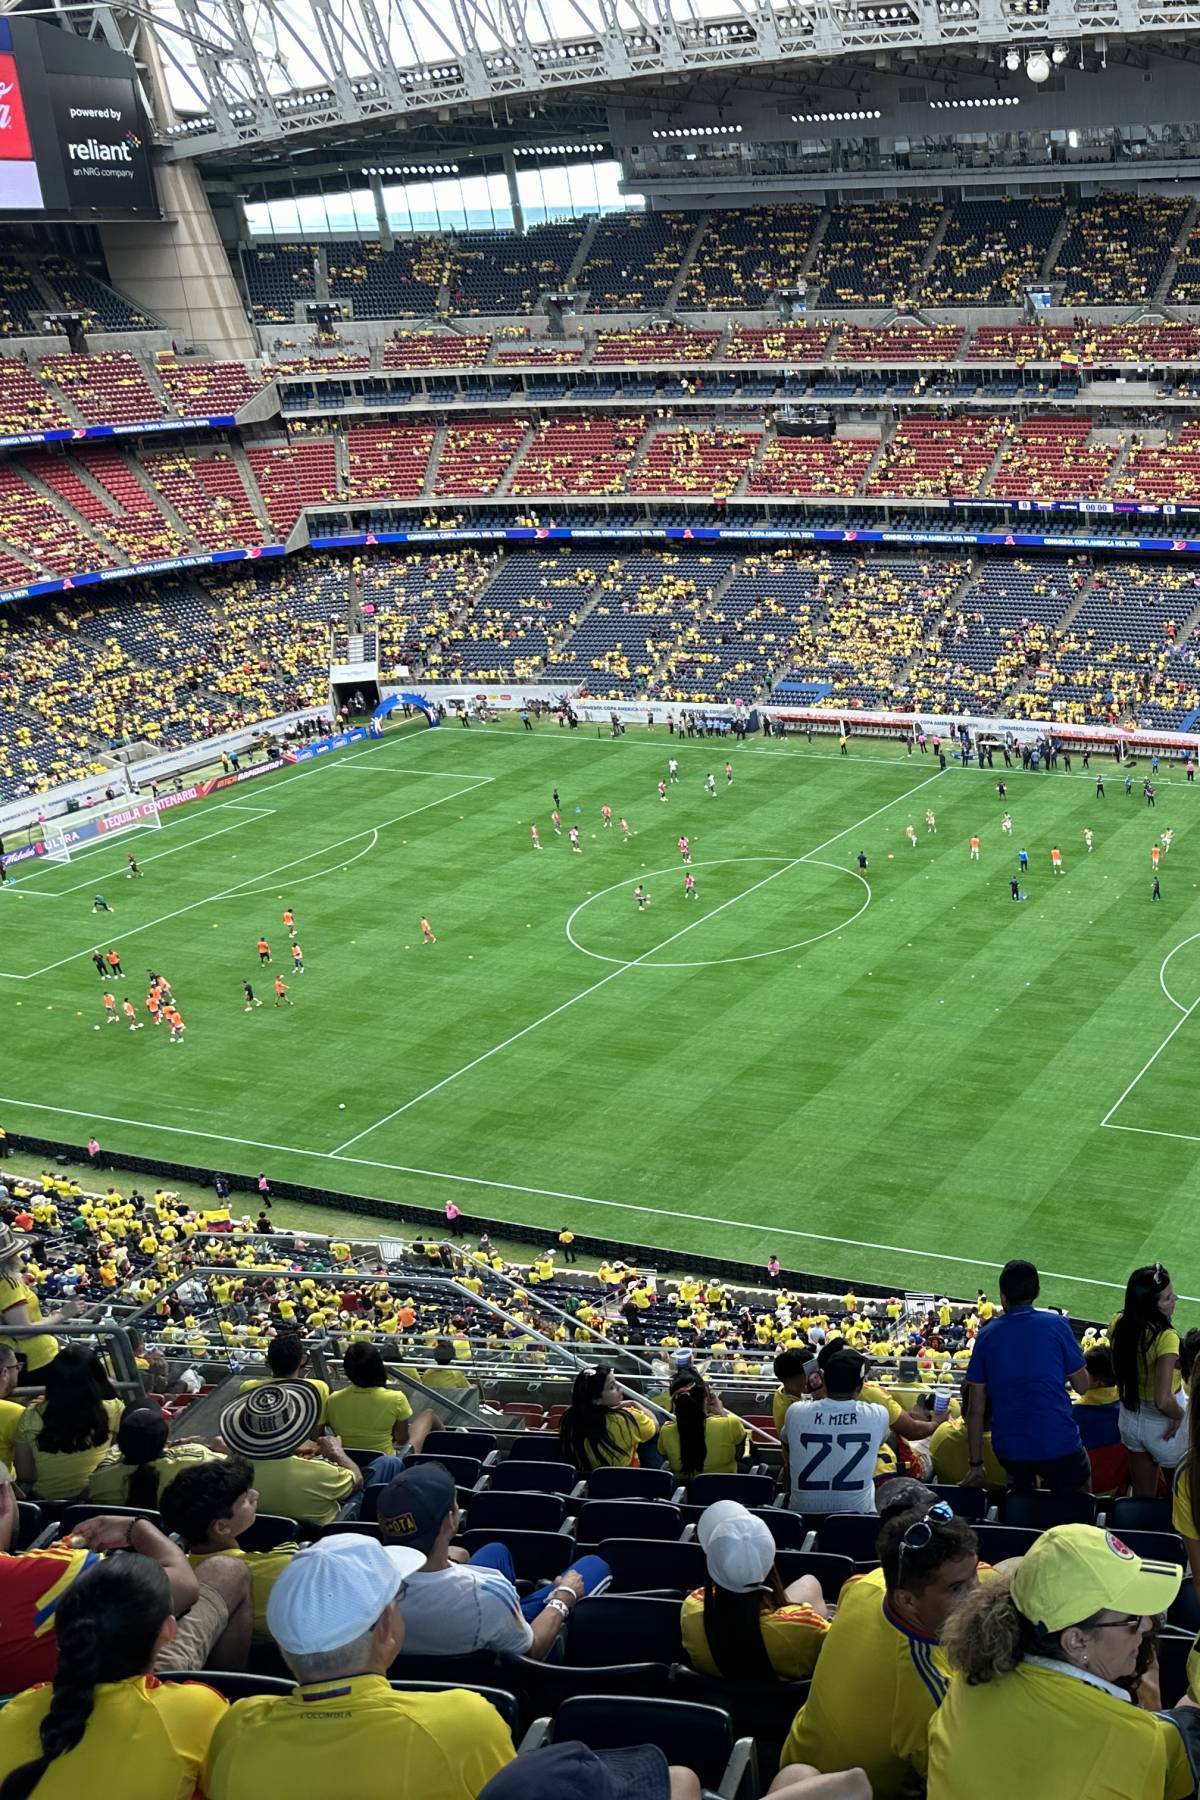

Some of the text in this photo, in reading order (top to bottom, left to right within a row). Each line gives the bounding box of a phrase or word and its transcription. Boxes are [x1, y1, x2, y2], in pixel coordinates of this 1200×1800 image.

[70, 108, 121, 121] powered by
[69, 139, 132, 161] reliant
[73, 167, 134, 180] an NRG company
[103, 808, 141, 830] TEQUILA
[142, 787, 198, 816] CENTENARIO
[44, 832, 80, 850] ULTRA
[828, 1413, 858, 1426] MIER
[798, 1433, 872, 1491] 22
